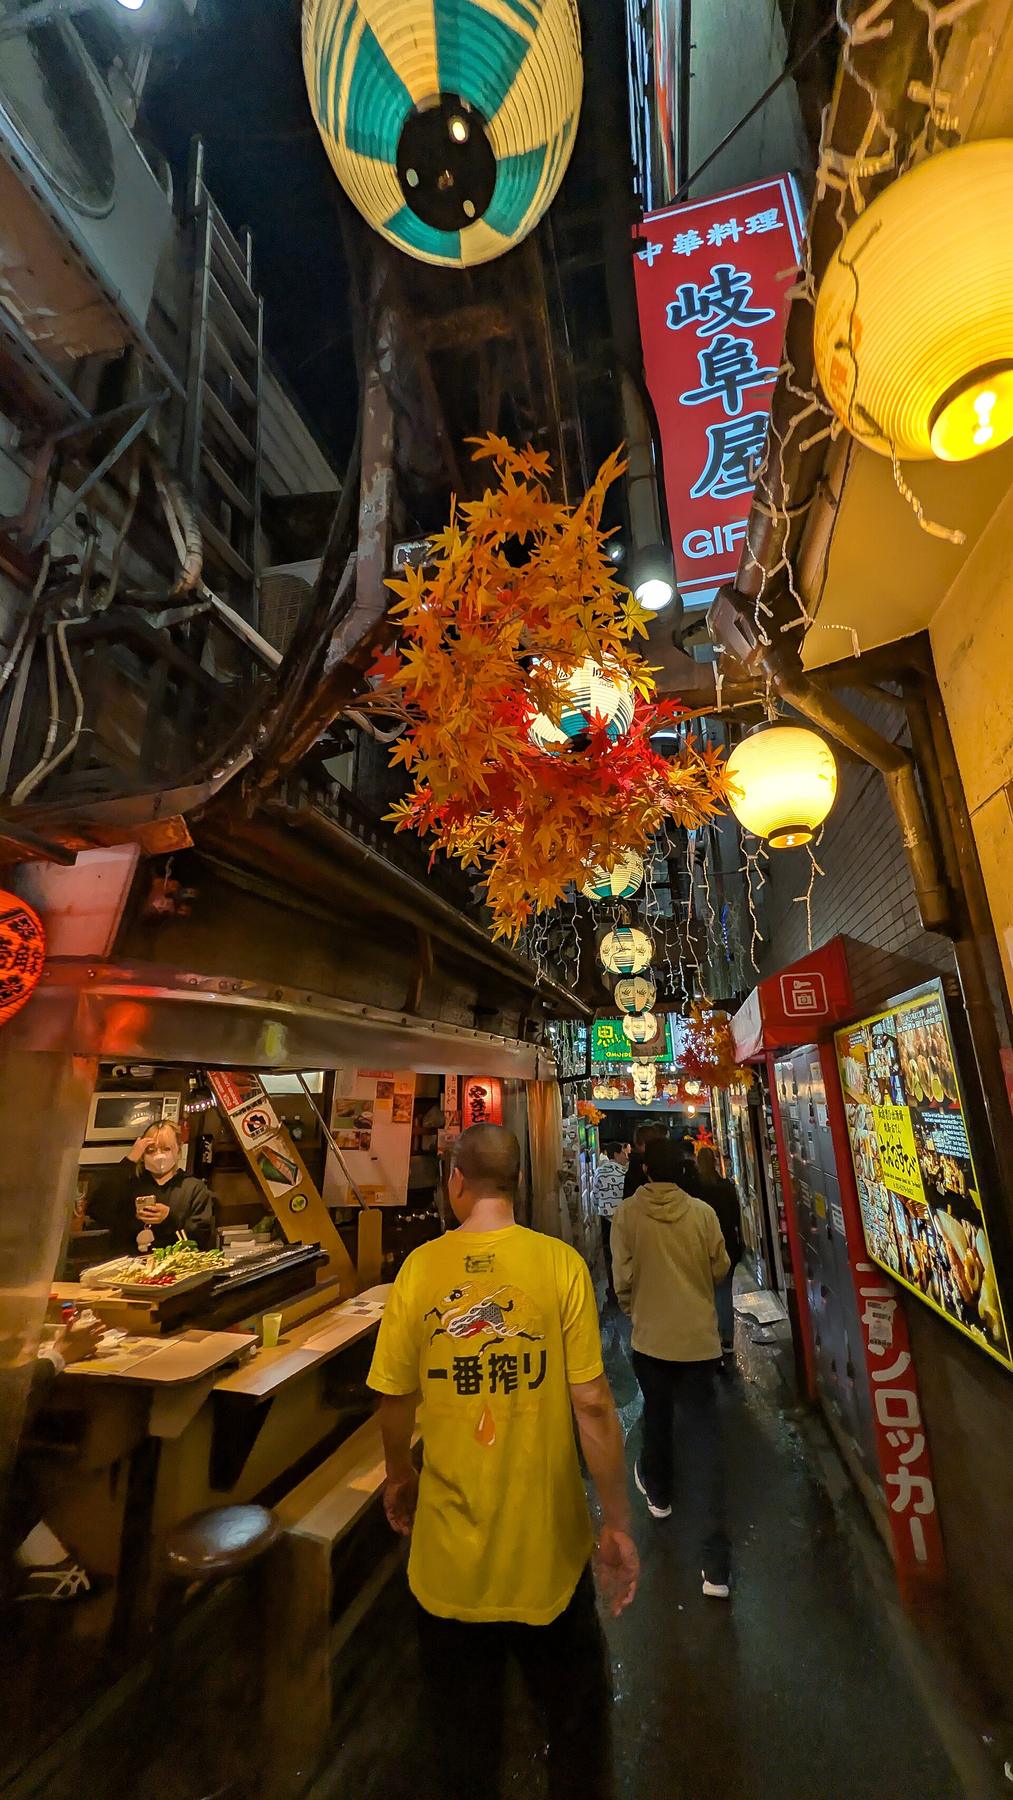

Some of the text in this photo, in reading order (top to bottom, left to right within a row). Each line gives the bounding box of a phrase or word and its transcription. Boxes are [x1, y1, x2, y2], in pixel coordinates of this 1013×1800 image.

[637, 207, 784, 268] 中華料理
[666, 263, 778, 501] 岐阜屋
[427, 1349, 547, 1395] 一番搾り
